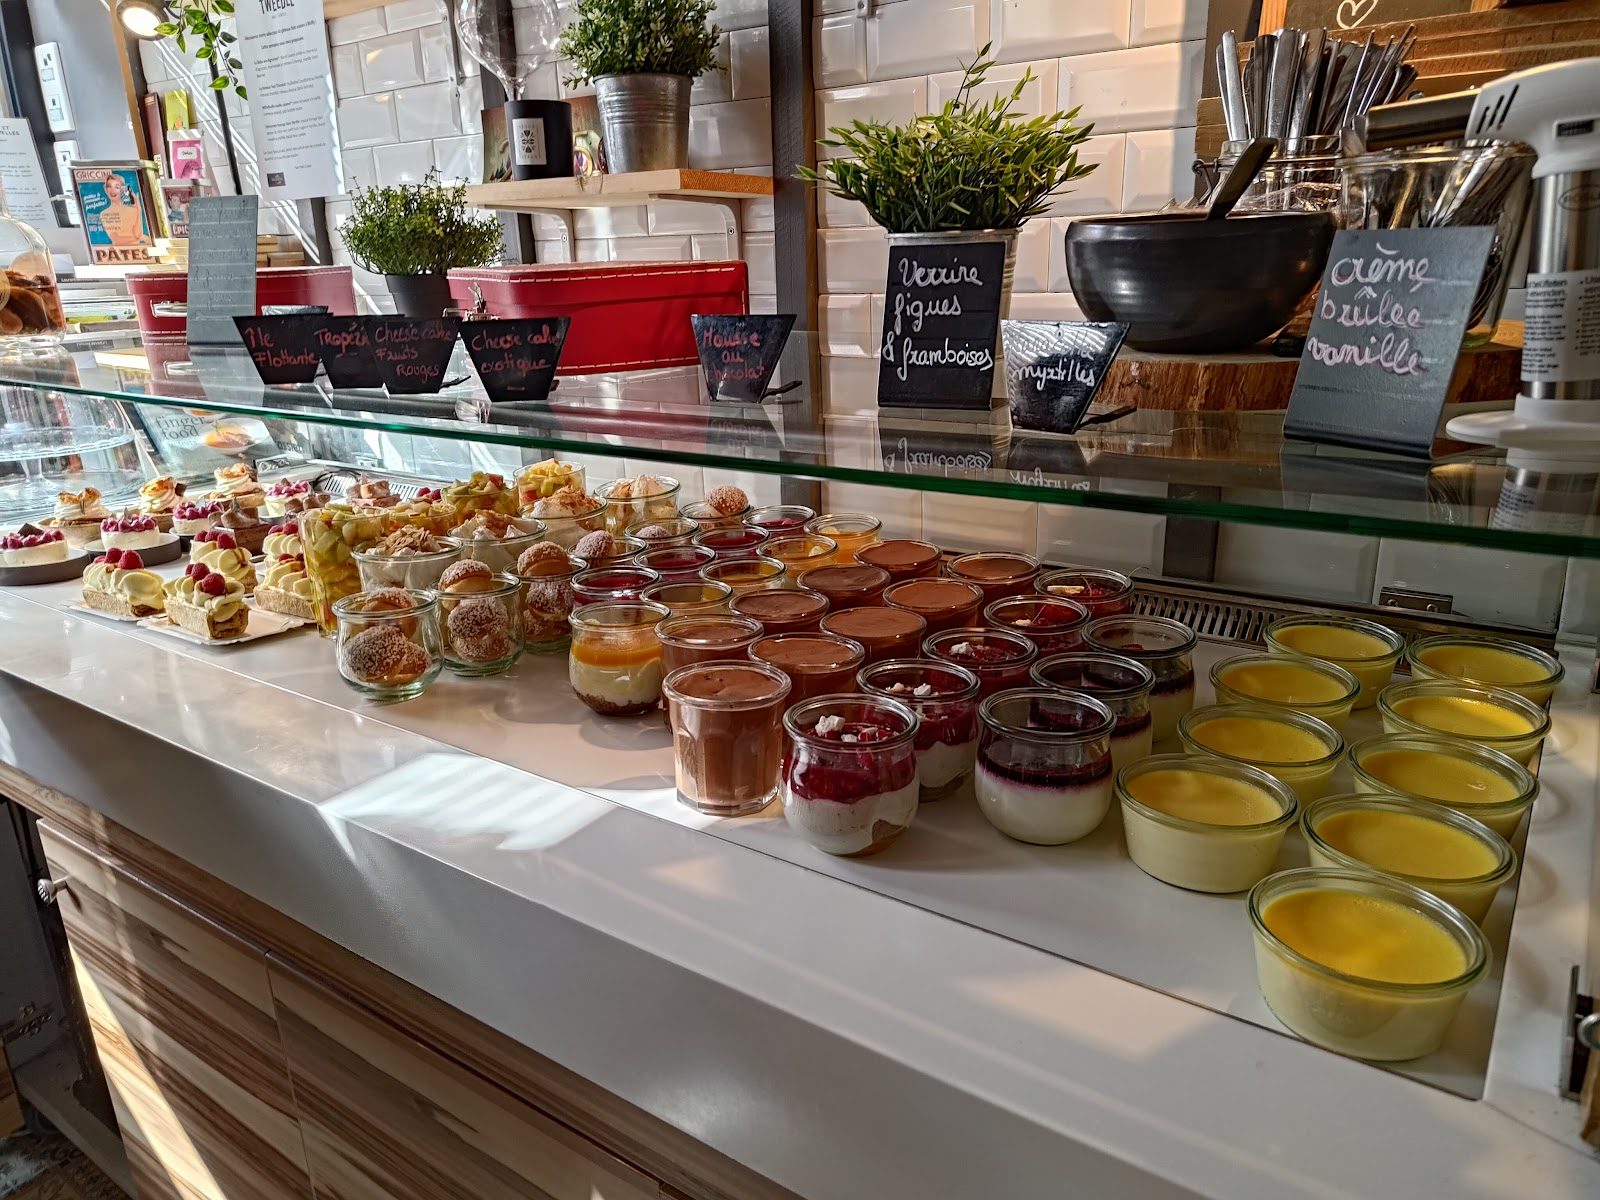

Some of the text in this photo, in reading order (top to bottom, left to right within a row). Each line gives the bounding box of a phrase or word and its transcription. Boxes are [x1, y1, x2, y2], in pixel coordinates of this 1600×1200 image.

[95, 247, 152, 262] PÂTES
[898, 257, 983, 287] Verrine
[894, 292, 962, 336] figues
[896, 337, 994, 381] framboises
[1307, 333, 1428, 375] vanille
[161, 425, 199, 440] food
